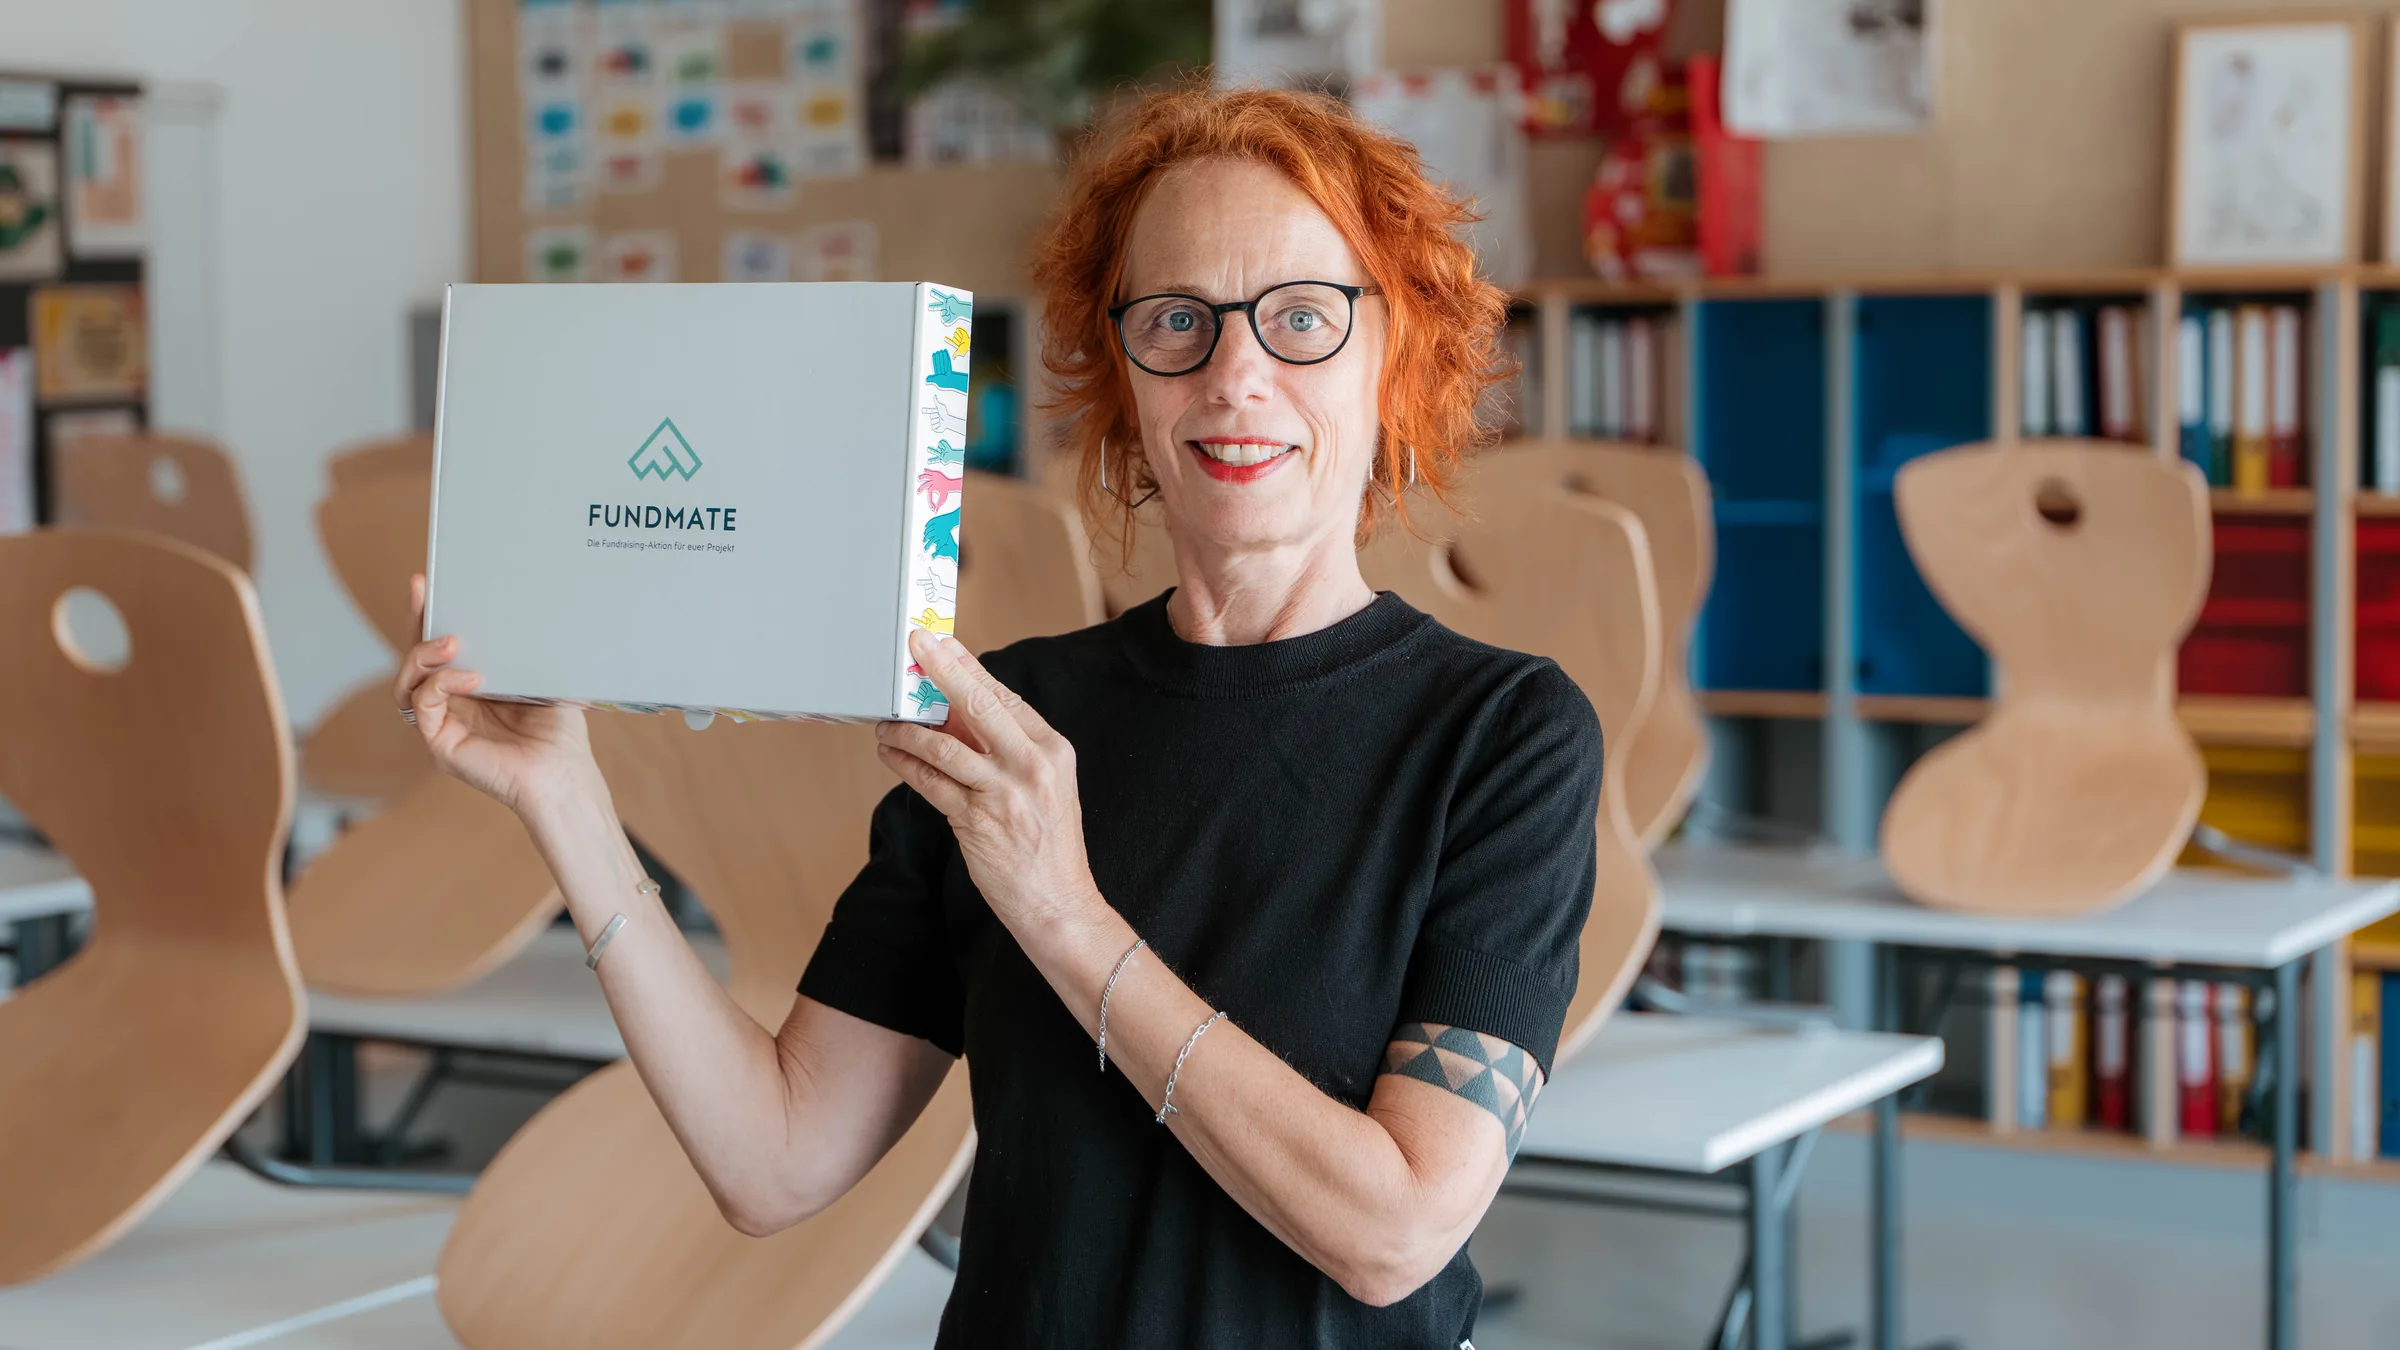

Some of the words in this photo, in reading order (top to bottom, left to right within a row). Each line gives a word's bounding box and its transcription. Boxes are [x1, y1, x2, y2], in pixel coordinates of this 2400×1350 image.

[588, 503, 737, 532] FUNDMATE
[587, 538, 600, 548] Die
[601, 539, 673, 552] Fundraising-Aktion
[674, 541, 685, 550] für
[687, 544, 705, 552] euer
[706, 542, 735, 554] Projekt
